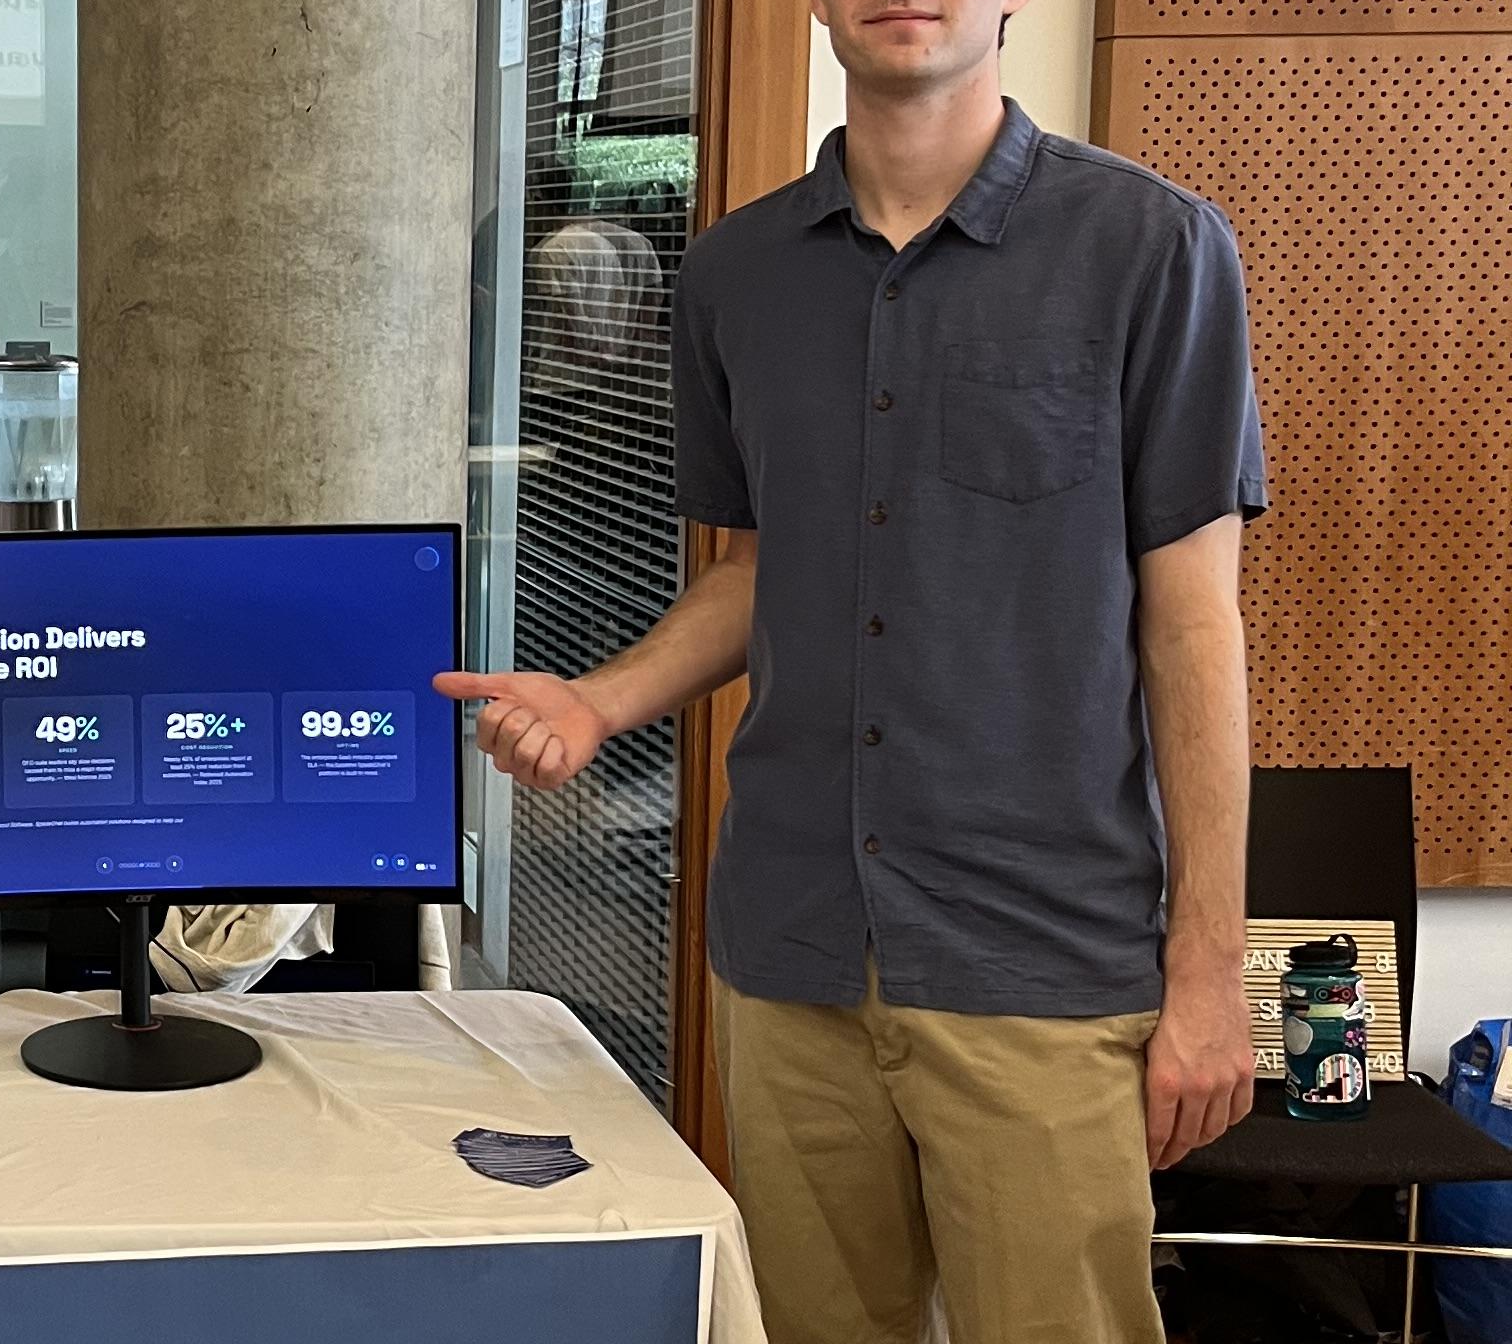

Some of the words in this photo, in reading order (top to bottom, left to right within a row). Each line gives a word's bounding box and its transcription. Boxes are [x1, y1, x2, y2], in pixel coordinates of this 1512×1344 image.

[45, 625, 146, 650] Delivers
[15, 655, 58, 678] ROI
[35, 716, 100, 743] 49%
[166, 712, 246, 739] 25%+
[301, 710, 395, 737] 99.9%
[1374, 953, 1390, 974] 8
[1372, 1051, 1400, 1073] 40
